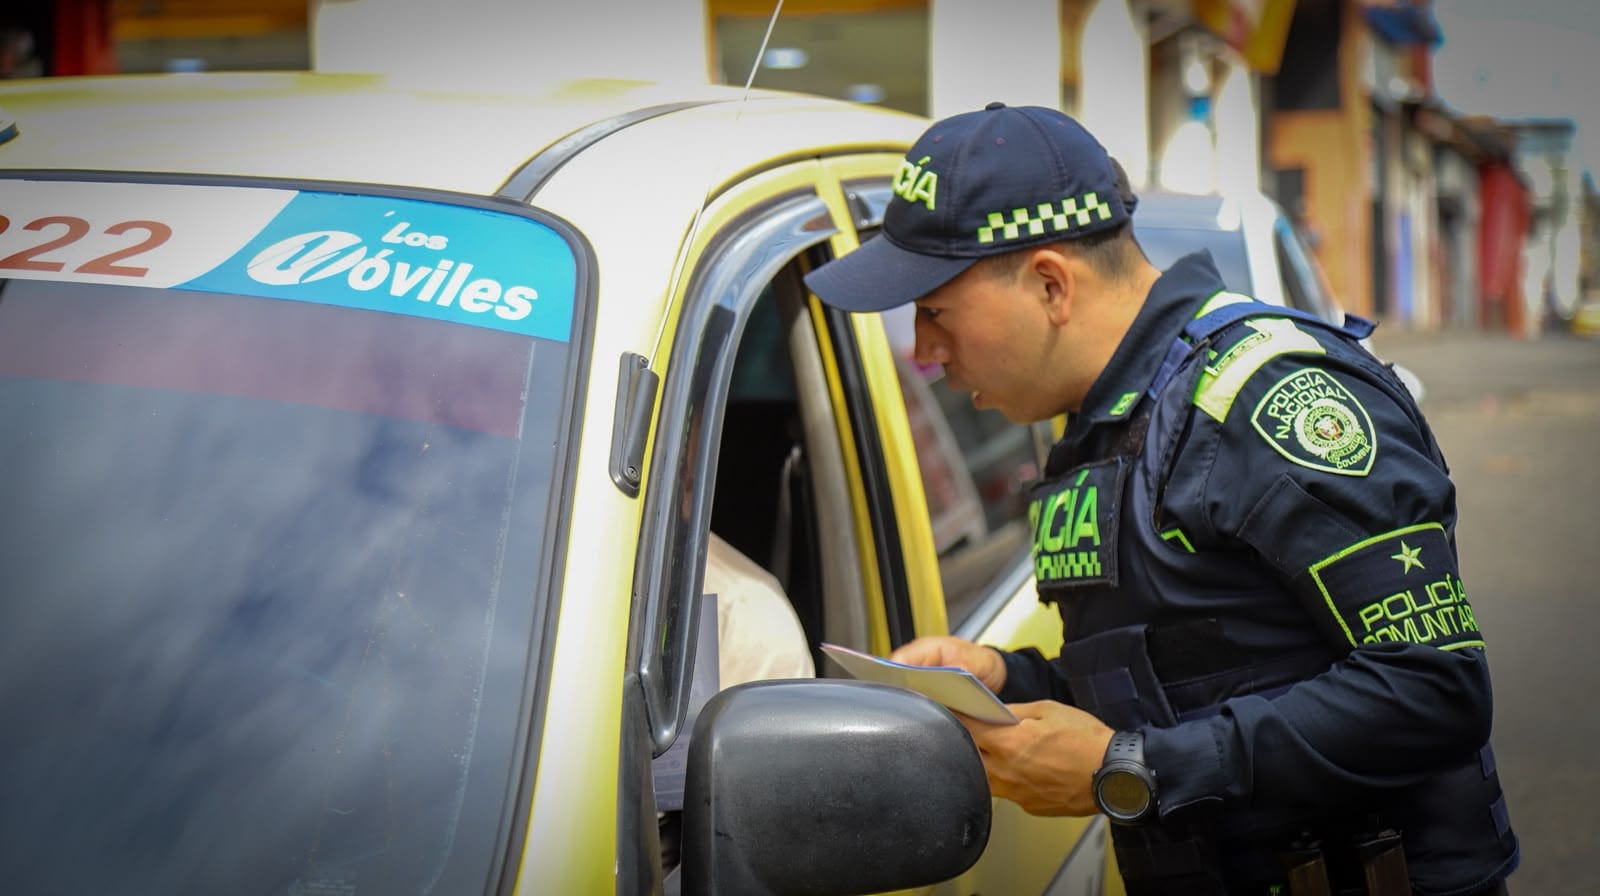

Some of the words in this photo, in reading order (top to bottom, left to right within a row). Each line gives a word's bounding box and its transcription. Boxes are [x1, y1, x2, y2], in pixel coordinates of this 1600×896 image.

[0, 214, 172, 278] 22
[381, 221, 449, 250] Los
[246, 230, 538, 321] Móviles
[1275, 385, 1347, 439] NACIONAL
[1359, 573, 1468, 632] POLICÍA
